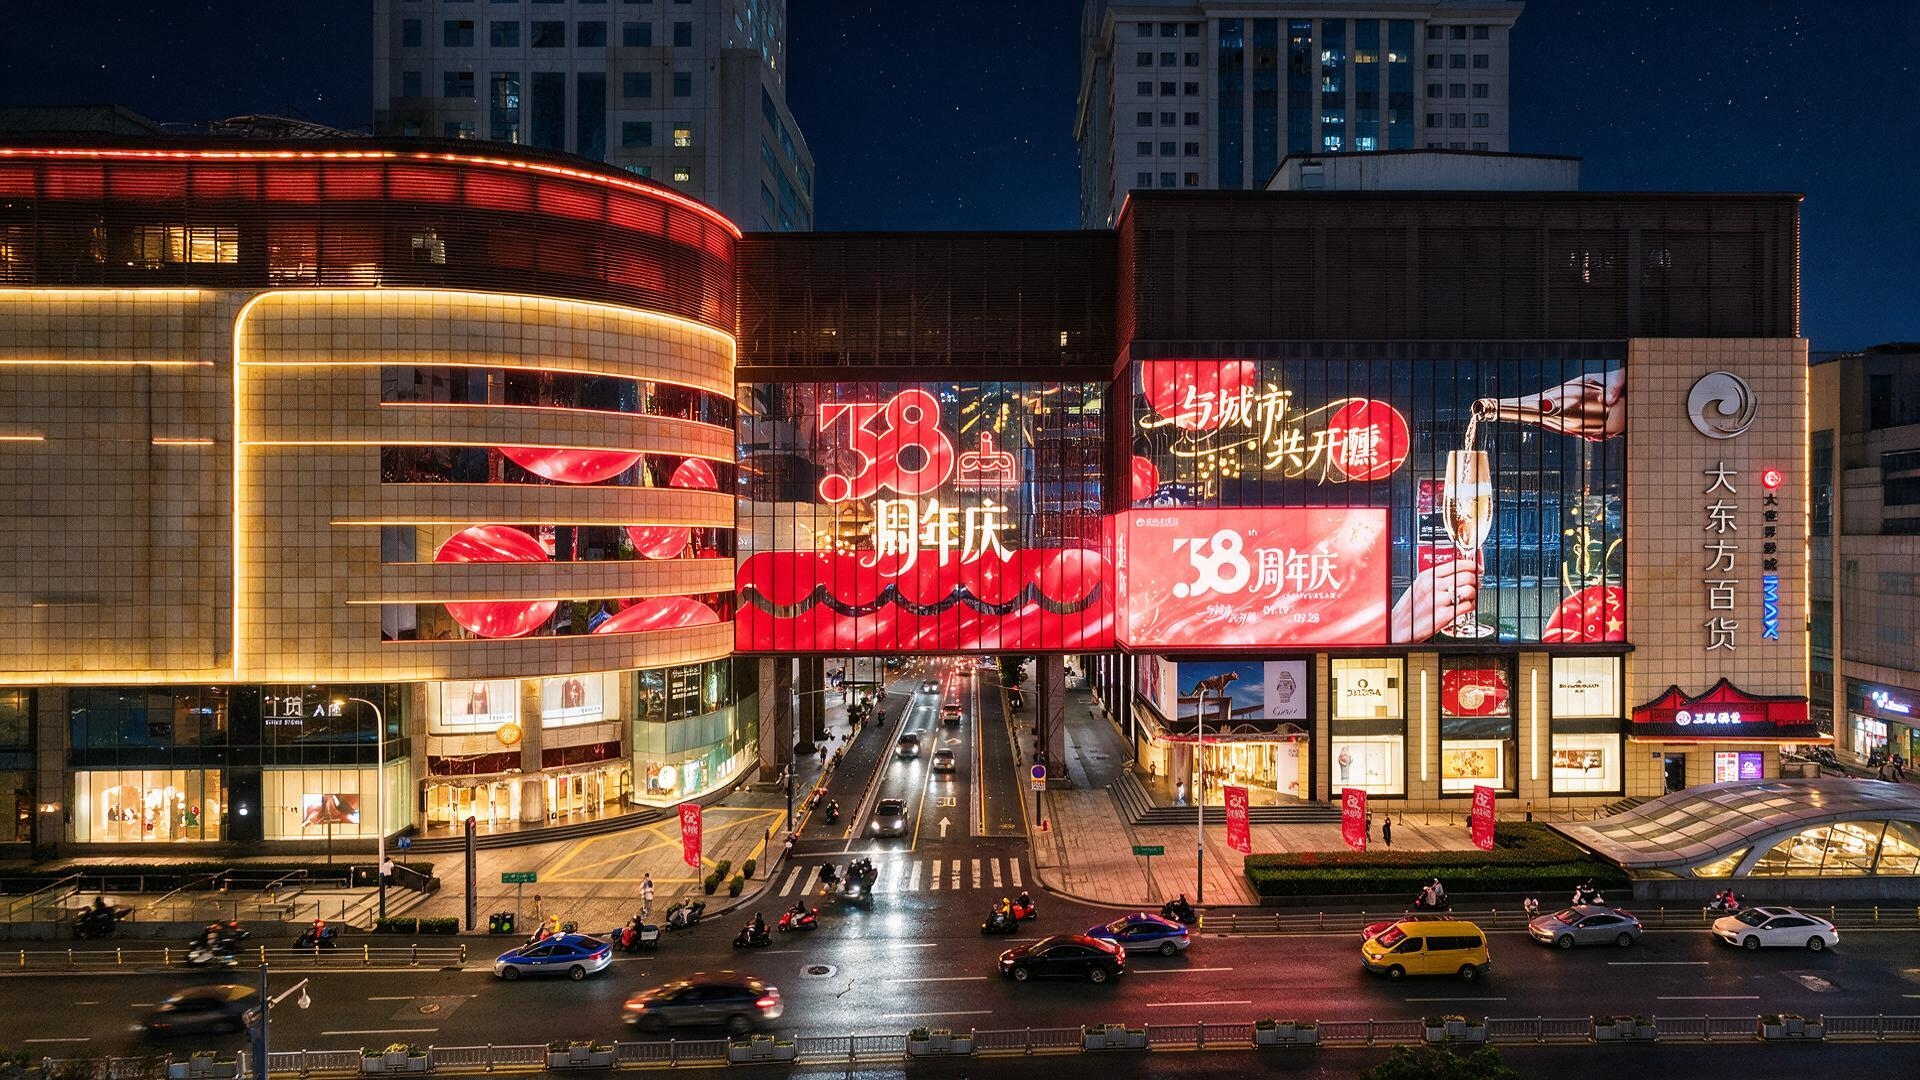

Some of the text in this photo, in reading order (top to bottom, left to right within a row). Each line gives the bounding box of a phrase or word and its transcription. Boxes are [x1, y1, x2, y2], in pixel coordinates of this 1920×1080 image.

[818, 389, 955, 503] 38
[1180, 383, 1293, 446] 与城市
[860, 498, 1016, 578] 周年庆
[1172, 528, 1251, 599] 38
[1704, 461, 1739, 652] 大东方百货
[1249, 547, 1342, 599] 周年庆
[1762, 575, 1779, 640] IMAX
[936, 796, 957, 807] 30
